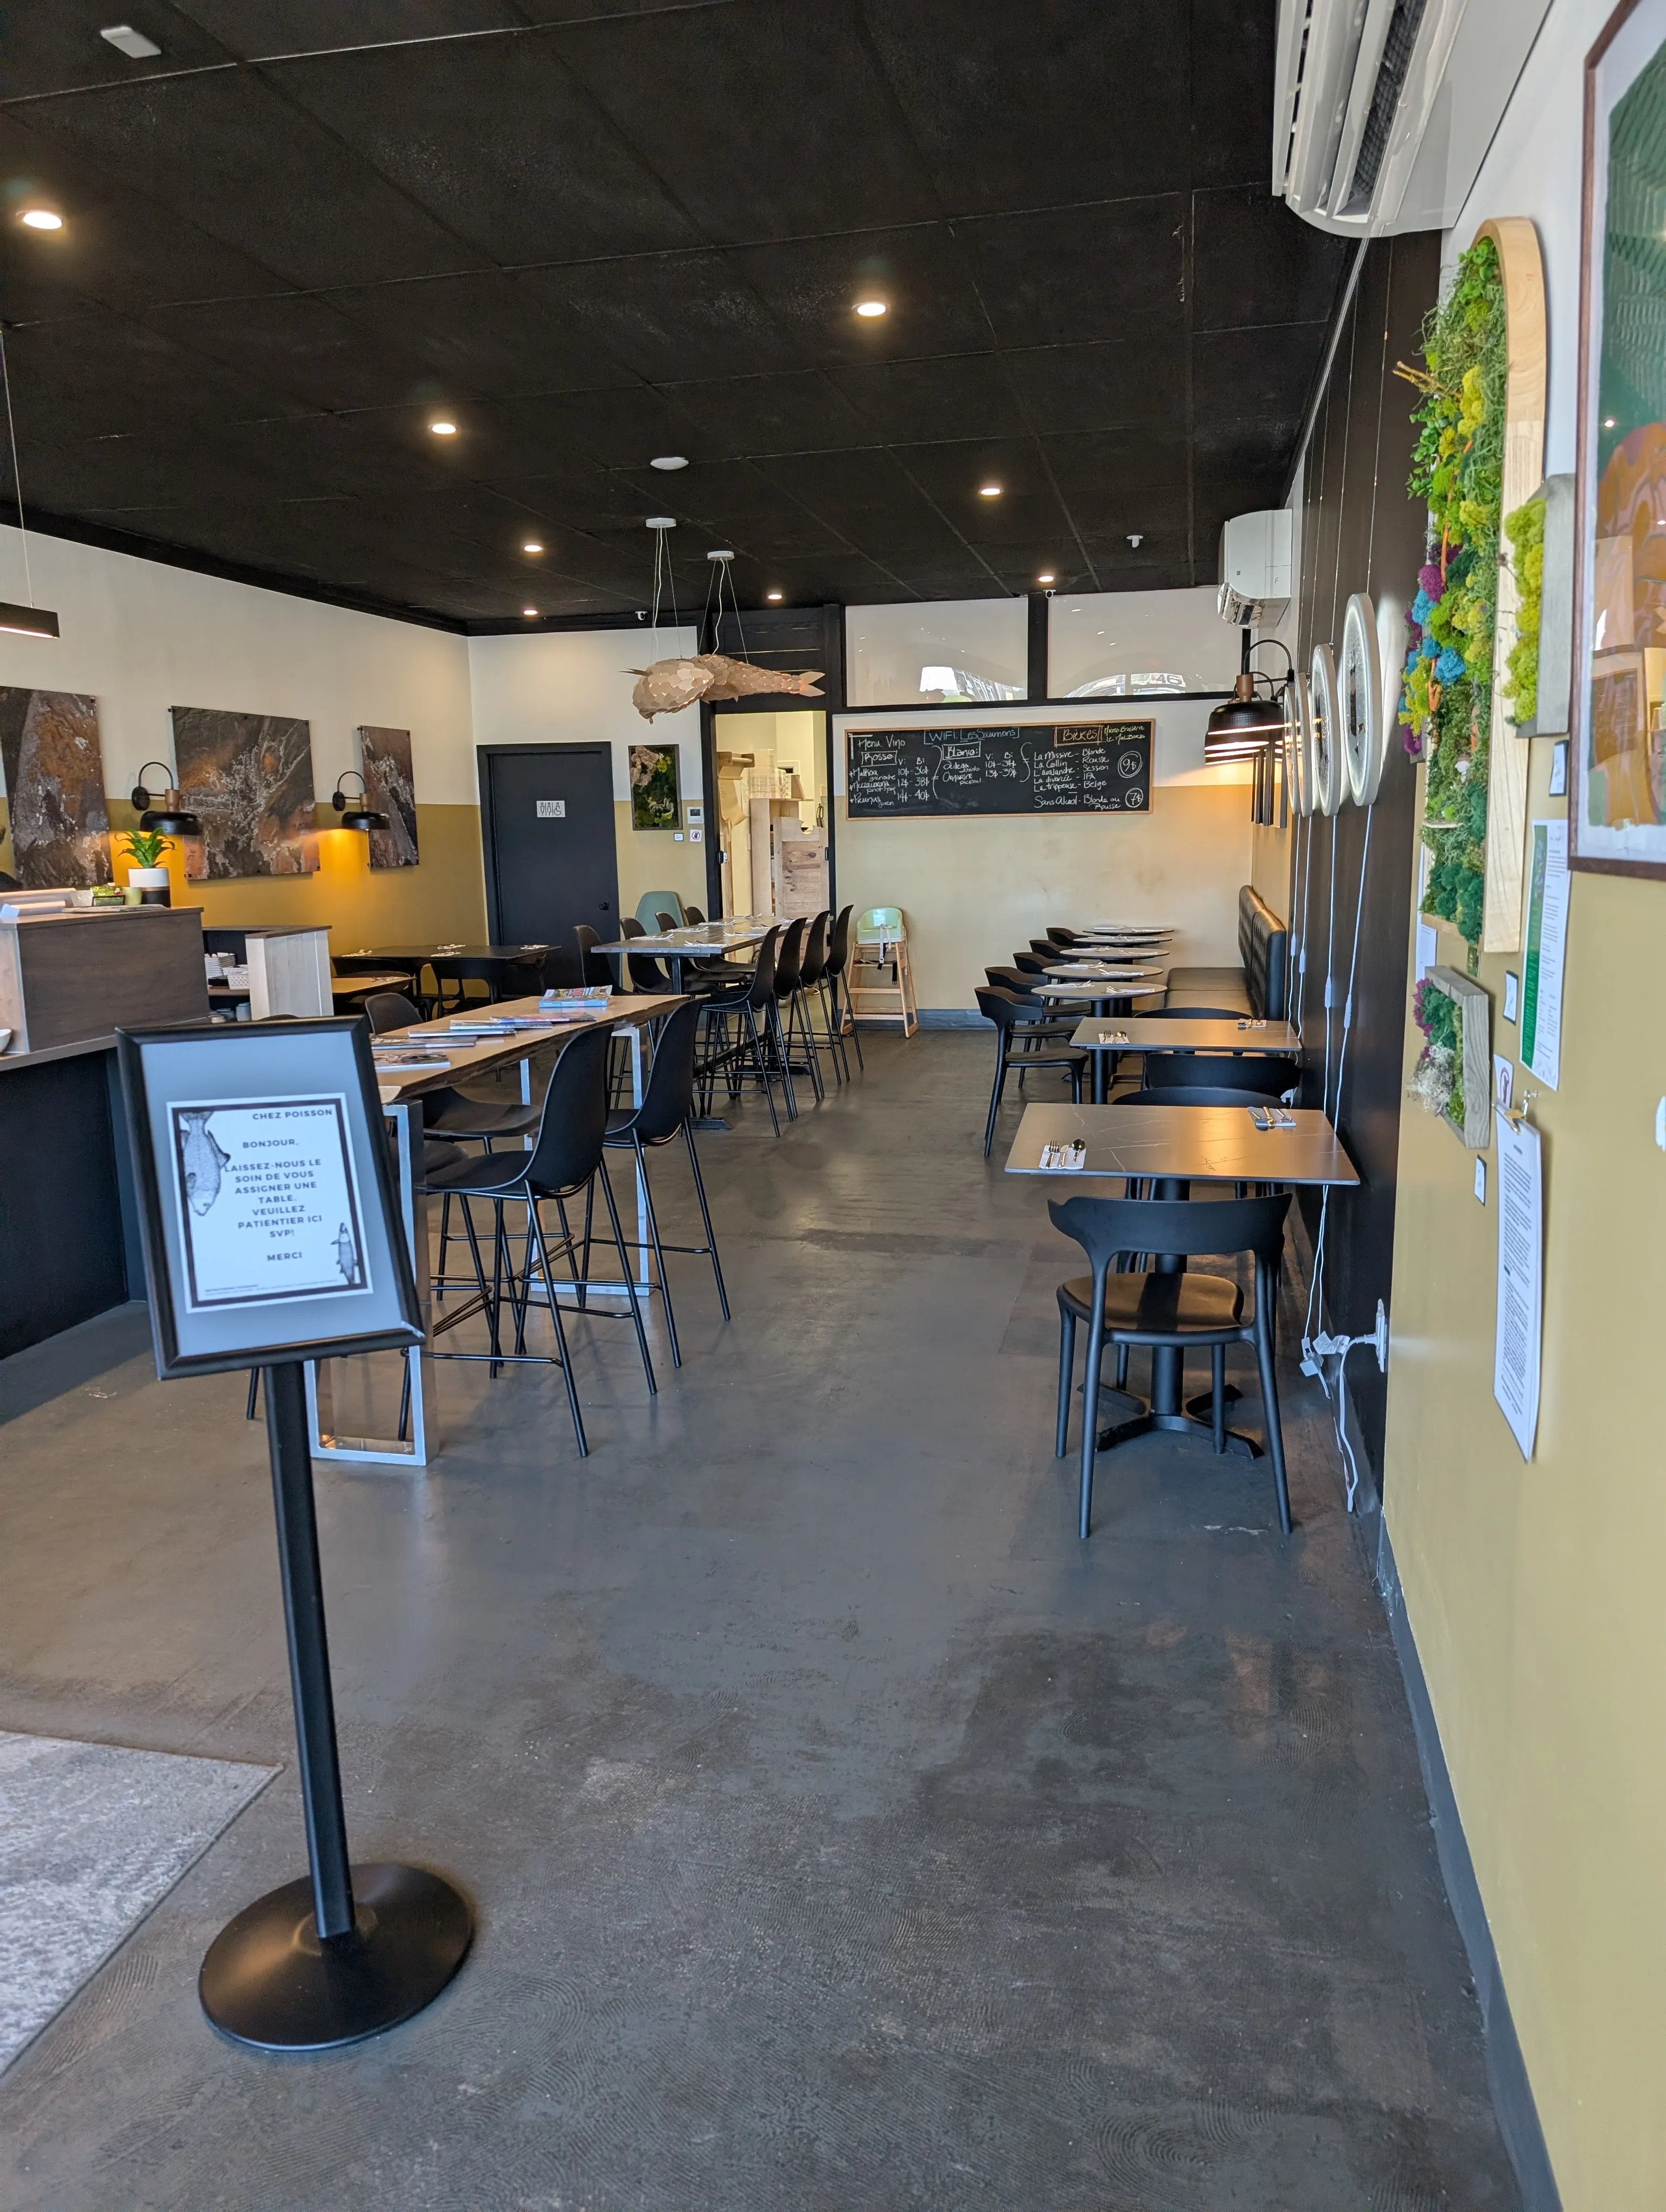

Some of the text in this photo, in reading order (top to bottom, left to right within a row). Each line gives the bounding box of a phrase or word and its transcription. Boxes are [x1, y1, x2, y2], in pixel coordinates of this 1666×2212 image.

[857, 735, 905, 751] Menu Vino
[1034, 752, 1043, 760] La
[1082, 748, 1106, 756] Blonde
[1123, 758, 1136, 772] 9$
[1084, 781, 1107, 790] Belge
[1130, 793, 1142, 805] 7$
[252, 1109, 332, 1120] CHEZ POISSON
[224, 1159, 306, 1172] LAISSEZ-NOUS
[235, 1171, 314, 1183] SOIN DE VOUS
[235, 1181, 317, 1194] ASSIGNER UNE
[252, 1205, 305, 1216] VEUILLEZ
[238, 1215, 322, 1229] PATIENTIER ICI
[269, 1229, 294, 1238] SVP!
[267, 1251, 303, 1262] MERCI
